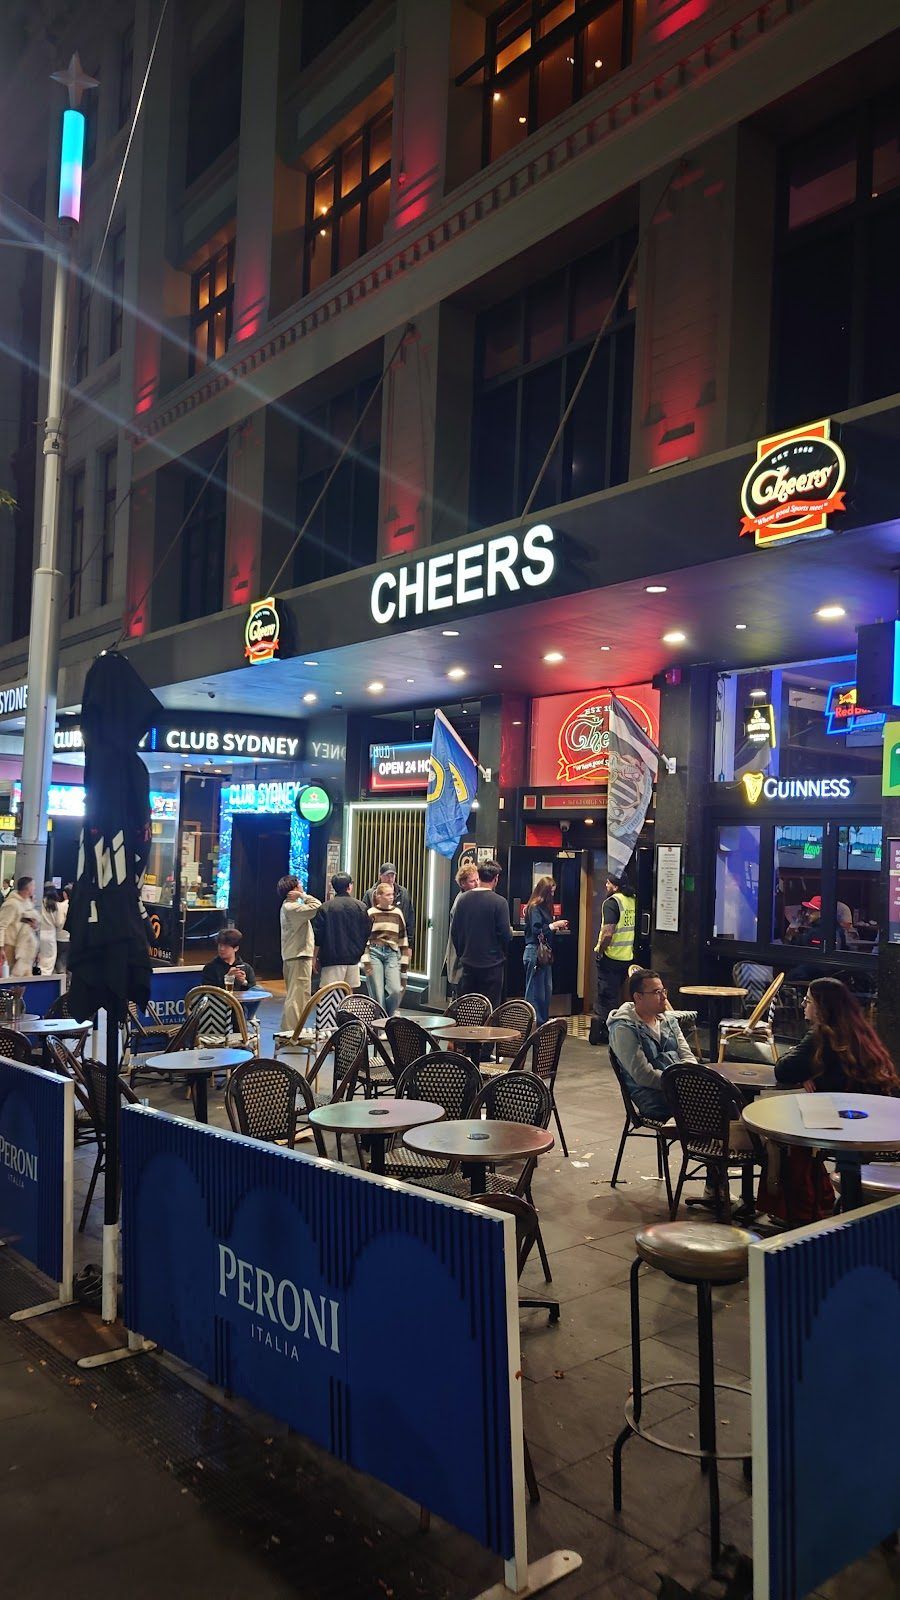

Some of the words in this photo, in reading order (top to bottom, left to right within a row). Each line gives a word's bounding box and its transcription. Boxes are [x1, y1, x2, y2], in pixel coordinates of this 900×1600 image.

[752, 465, 838, 505] Cheers
[371, 524, 555, 624] CHEERS
[0, 685, 28, 714] SYDNE
[584, 706, 601, 715] EST
[836, 705, 853, 718] Red
[54, 730, 82, 748] CLUB
[166, 730, 219, 751] CLUB
[222, 733, 298, 756] SYDNEY
[565, 716, 609, 753] Che
[379, 761, 404, 775] OPEN
[405, 760, 416, 773] 24
[229, 783, 256, 804] CLUB
[763, 778, 851, 798] GUINNESS
[145, 999, 186, 1018] PERO
[0, 1135, 38, 1181] PERONI
[218, 1243, 340, 1354] PERONI
[251, 1323, 299, 1362] ITALIA
